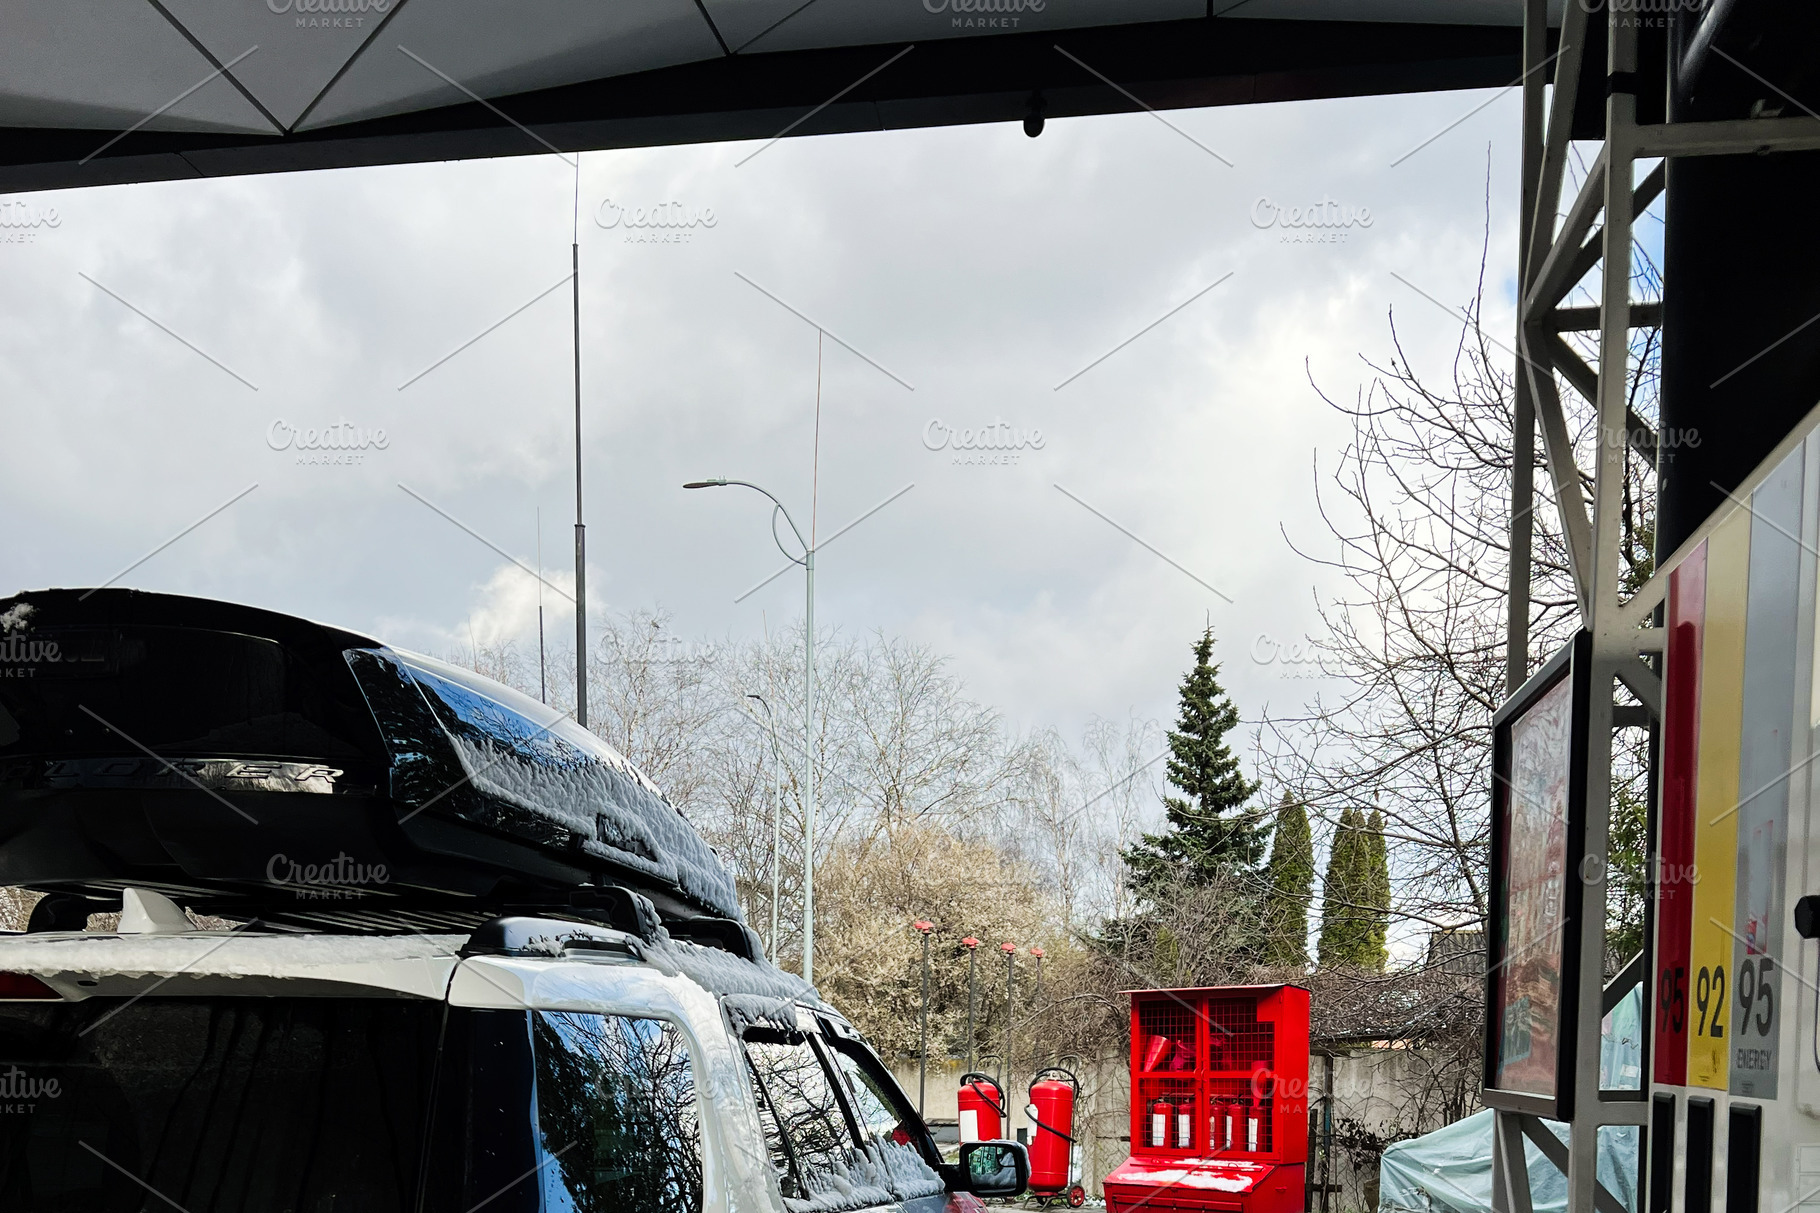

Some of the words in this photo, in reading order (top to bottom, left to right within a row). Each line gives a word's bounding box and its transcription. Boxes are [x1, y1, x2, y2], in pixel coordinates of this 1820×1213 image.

[1661, 967, 1685, 1034] 95
[1697, 965, 1725, 1038] 92
[1739, 958, 1774, 1037] 95
